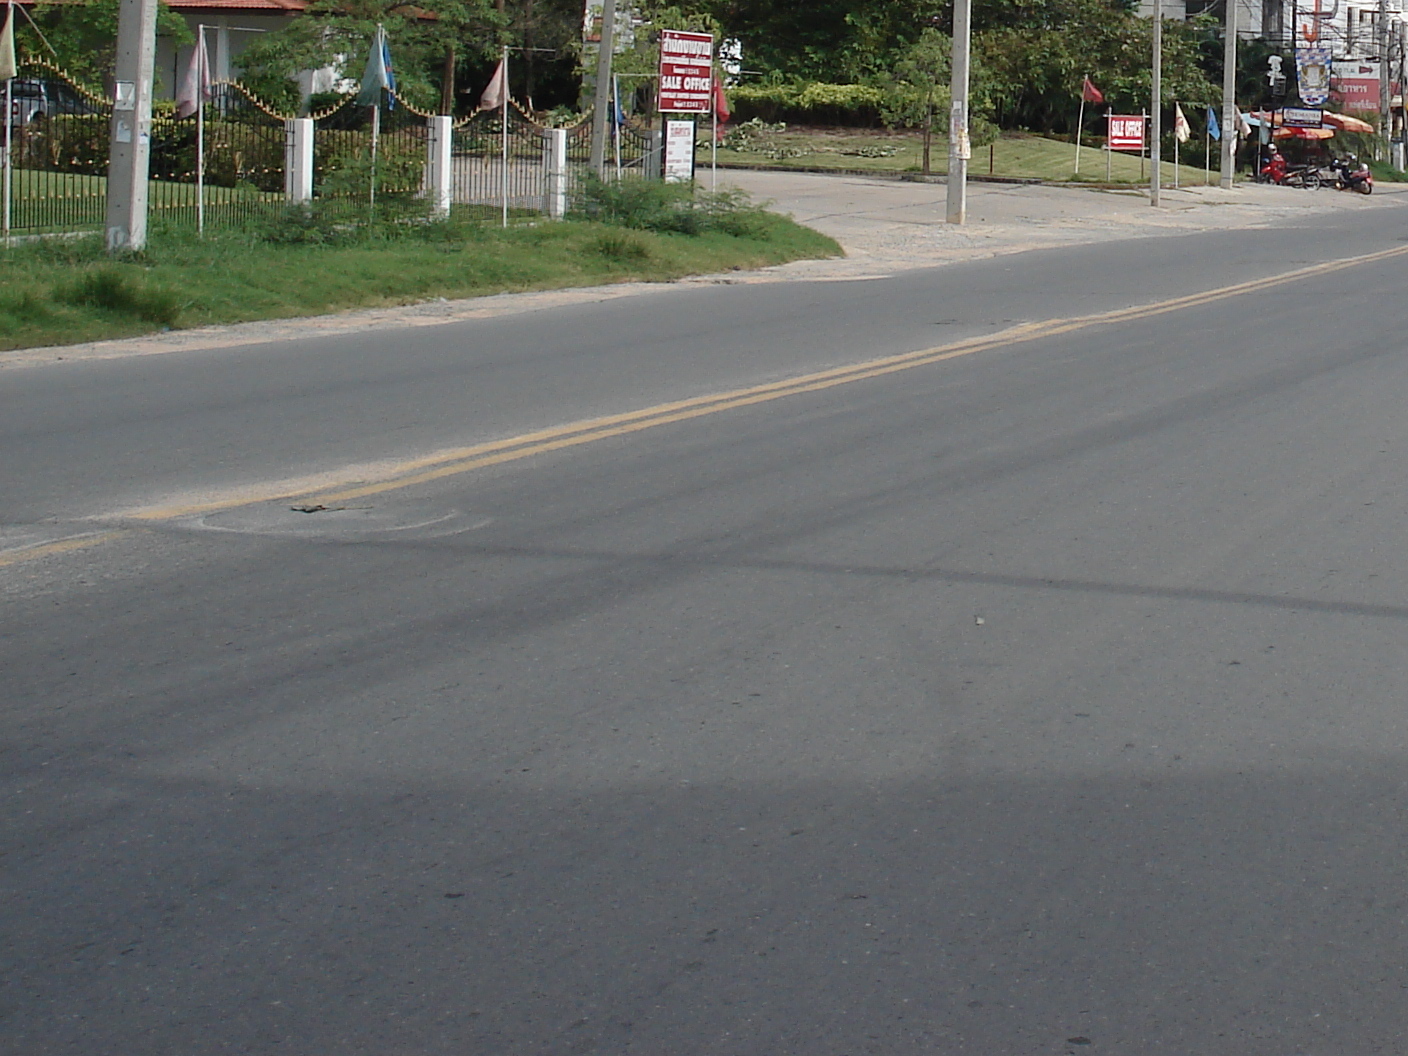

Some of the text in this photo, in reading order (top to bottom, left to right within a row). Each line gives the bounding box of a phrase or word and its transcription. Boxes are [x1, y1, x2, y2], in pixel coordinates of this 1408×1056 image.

[662, 76, 710, 91] SALE OFFICE
[1112, 120, 1142, 137] SALE OFFICE
